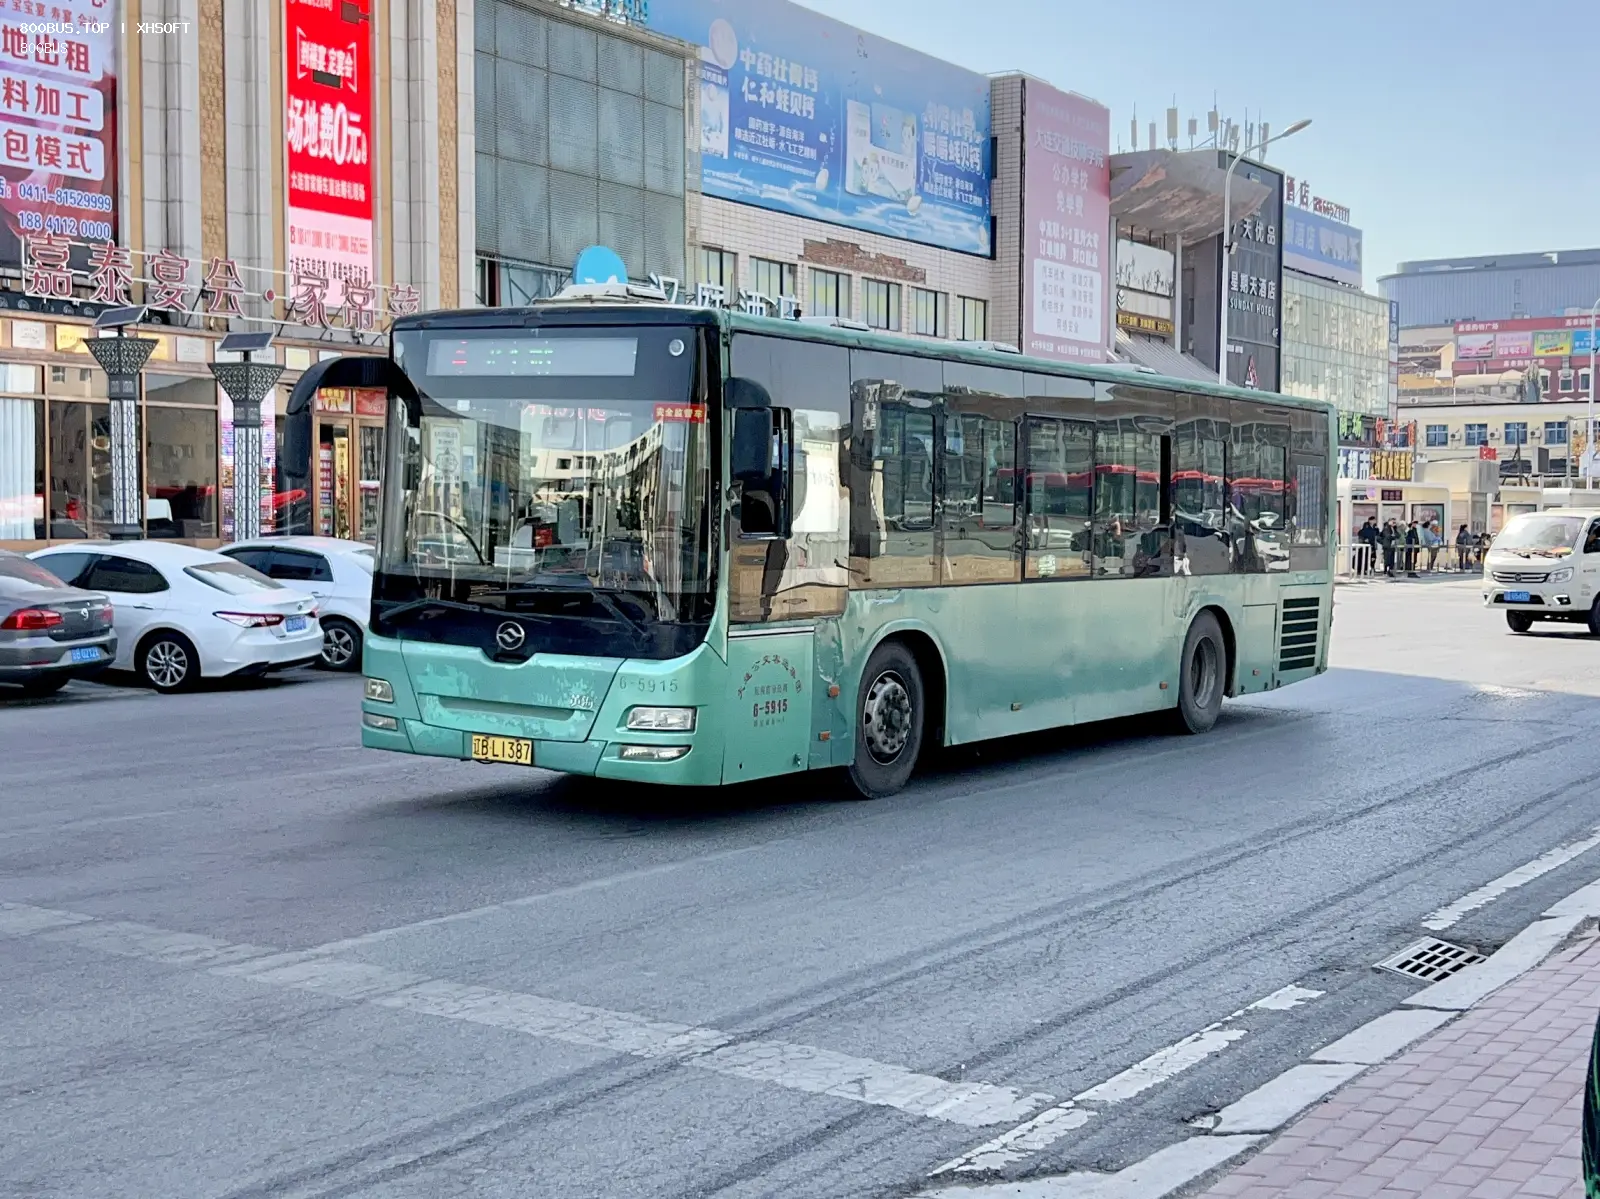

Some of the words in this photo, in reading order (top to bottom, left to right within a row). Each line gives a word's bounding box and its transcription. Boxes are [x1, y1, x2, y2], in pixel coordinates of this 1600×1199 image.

[2, 24, 91, 74] 地出租
[3, 76, 92, 122] 料加工
[4, 129, 92, 174] 包模式
[19, 183, 112, 212] 0411-81529999
[18, 211, 42, 229] 188
[45, 215, 77, 235] 4112
[80, 219, 111, 239] 0000
[1230, 270, 1276, 301] 星期天酒店
[1229, 297, 1254, 313] SUNDAY
[1256, 302, 1276, 319] HOTEL
[753, 698, 788, 718] G-5915
